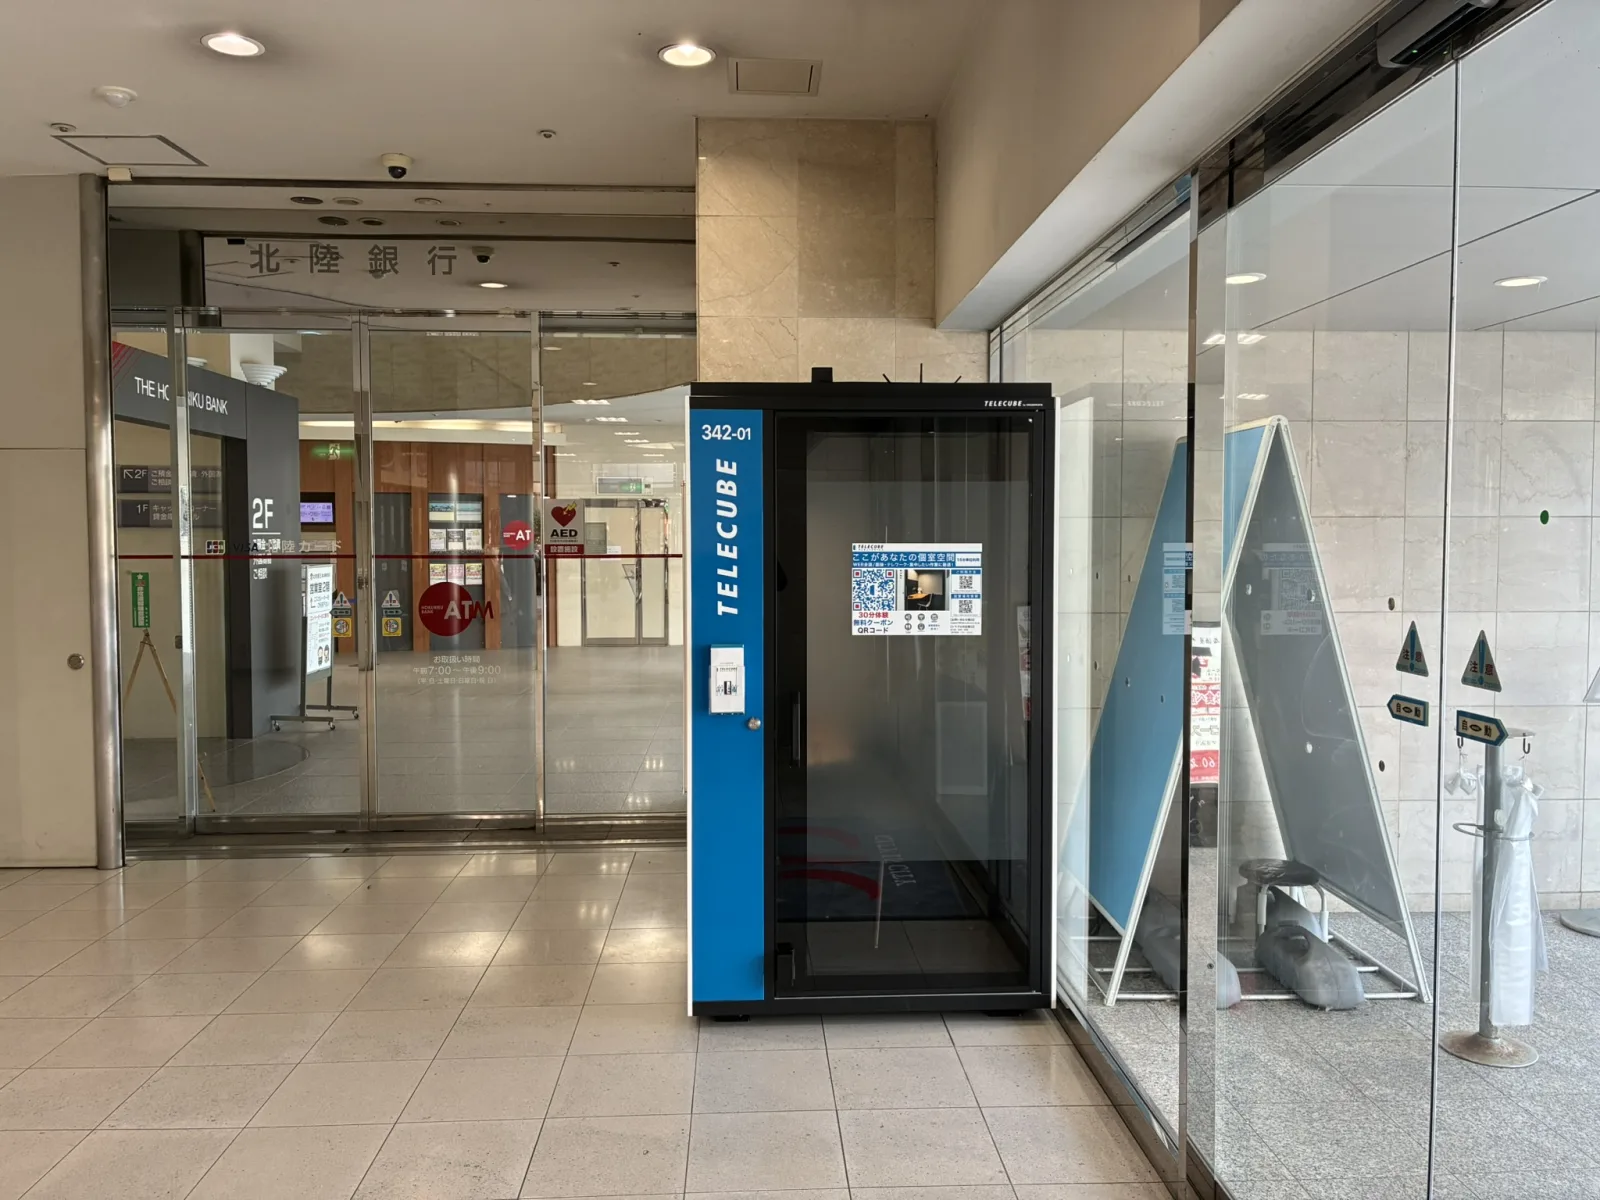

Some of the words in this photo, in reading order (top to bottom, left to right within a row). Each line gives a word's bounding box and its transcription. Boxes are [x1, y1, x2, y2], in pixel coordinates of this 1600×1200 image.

[249, 243, 458, 276] 北陸銀行
[134, 376, 156, 398] THE
[205, 396, 228, 415] BANK
[701, 424, 752, 441] 342-01
[134, 469, 148, 479] 2F
[136, 504, 149, 514] 1F
[252, 497, 274, 529] 2F
[550, 529, 578, 538] AED
[716, 457, 739, 616] TELECUBE
[852, 553, 955, 562] ここがあなたの個室空間
[443, 600, 495, 620] ATM
[858, 611, 889, 619] 30分体験
[853, 619, 894, 627] 無料クーポン
[432, 655, 481, 664] お取扱い時間
